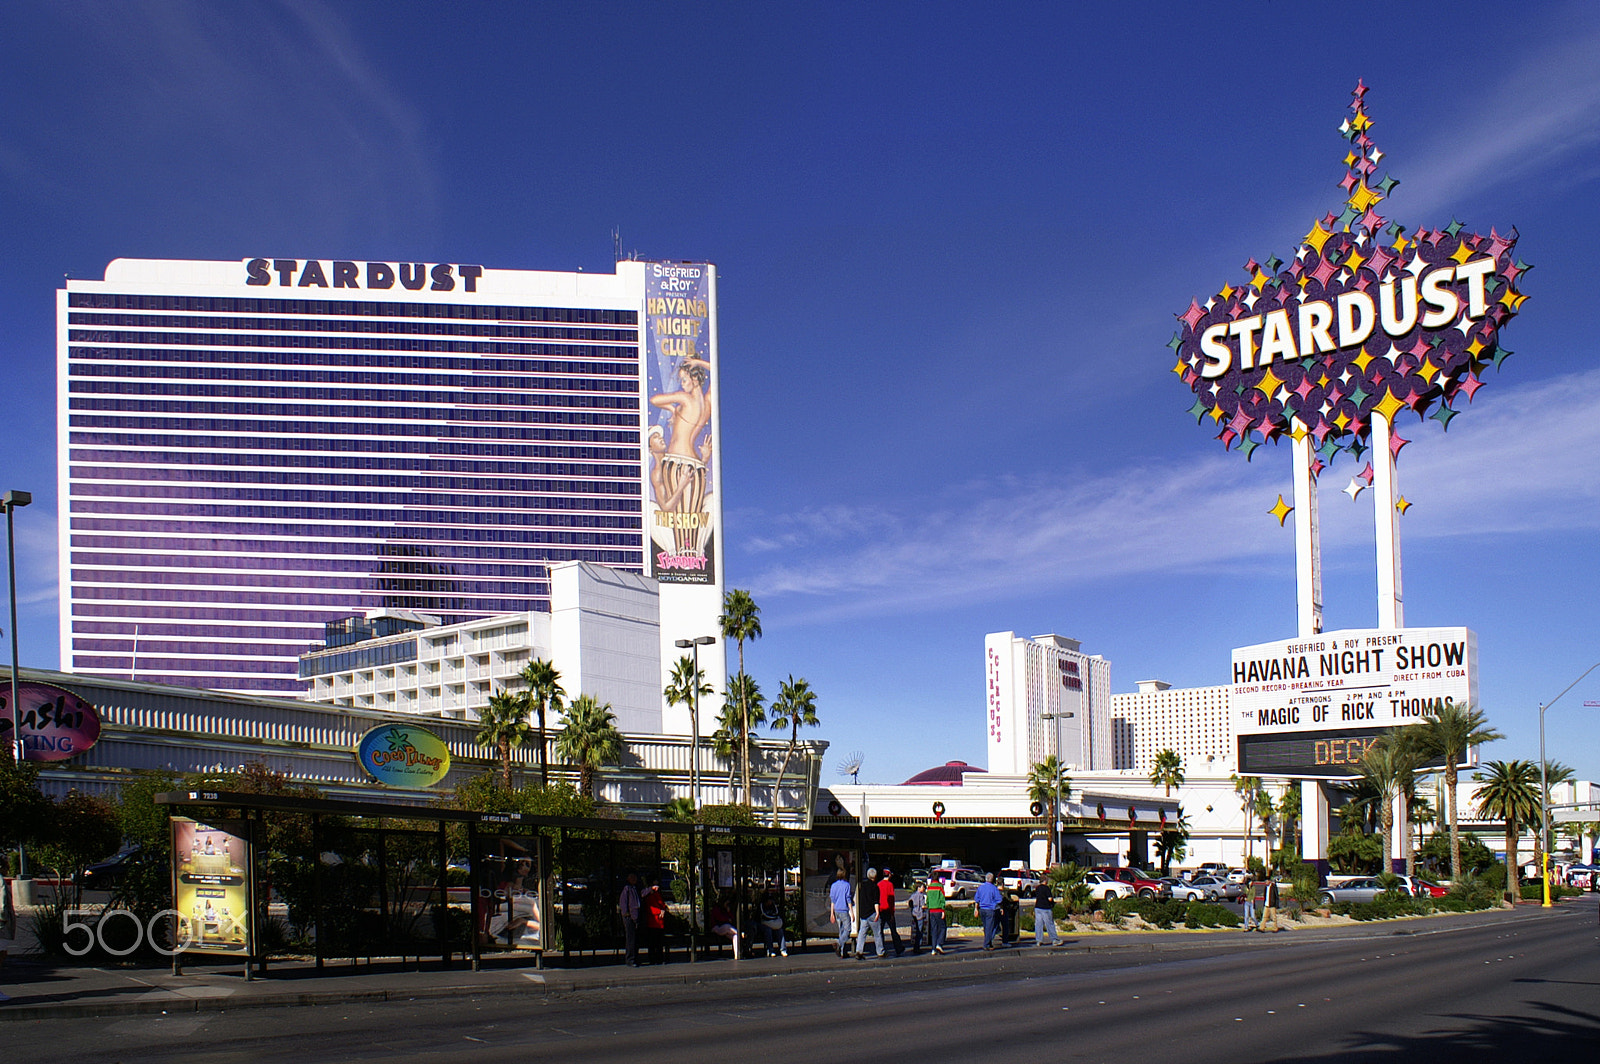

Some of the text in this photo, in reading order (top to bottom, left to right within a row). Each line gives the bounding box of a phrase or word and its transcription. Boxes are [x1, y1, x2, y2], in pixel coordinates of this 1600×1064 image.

[246, 258, 483, 293] STARDUST
[653, 264, 701, 278] SIEGFRIED
[647, 297, 707, 318] HAVANA
[656, 317, 700, 337] NIGHT
[1200, 256, 1496, 379] STARDUST
[661, 338, 695, 357] CLUB
[654, 510, 710, 529] THE SHOW
[1287, 635, 1403, 654] SIEGFRIED & ROY PRESENT
[1234, 641, 1465, 684] HAVANA NIGHT SHOW
[1394, 669, 1465, 682] DIRECT FROM CUBA
[988, 647, 996, 736] CIRCUS
[1235, 679, 1344, 695] SECOND RECORD-BREAKING YEAR
[994, 654, 1002, 743] CIRCUS
[1289, 695, 1332, 704] AFTERNOONS
[1347, 693, 1351, 701] 2
[1368, 691, 1382, 699] AND
[1388, 690, 1392, 698] 4
[1241, 710, 1254, 718] THE
[1258, 707, 1300, 726] MAGIC
[1312, 704, 1329, 723] OF
[1341, 701, 1374, 721] RICK
[479, 885, 539, 899] bebe
